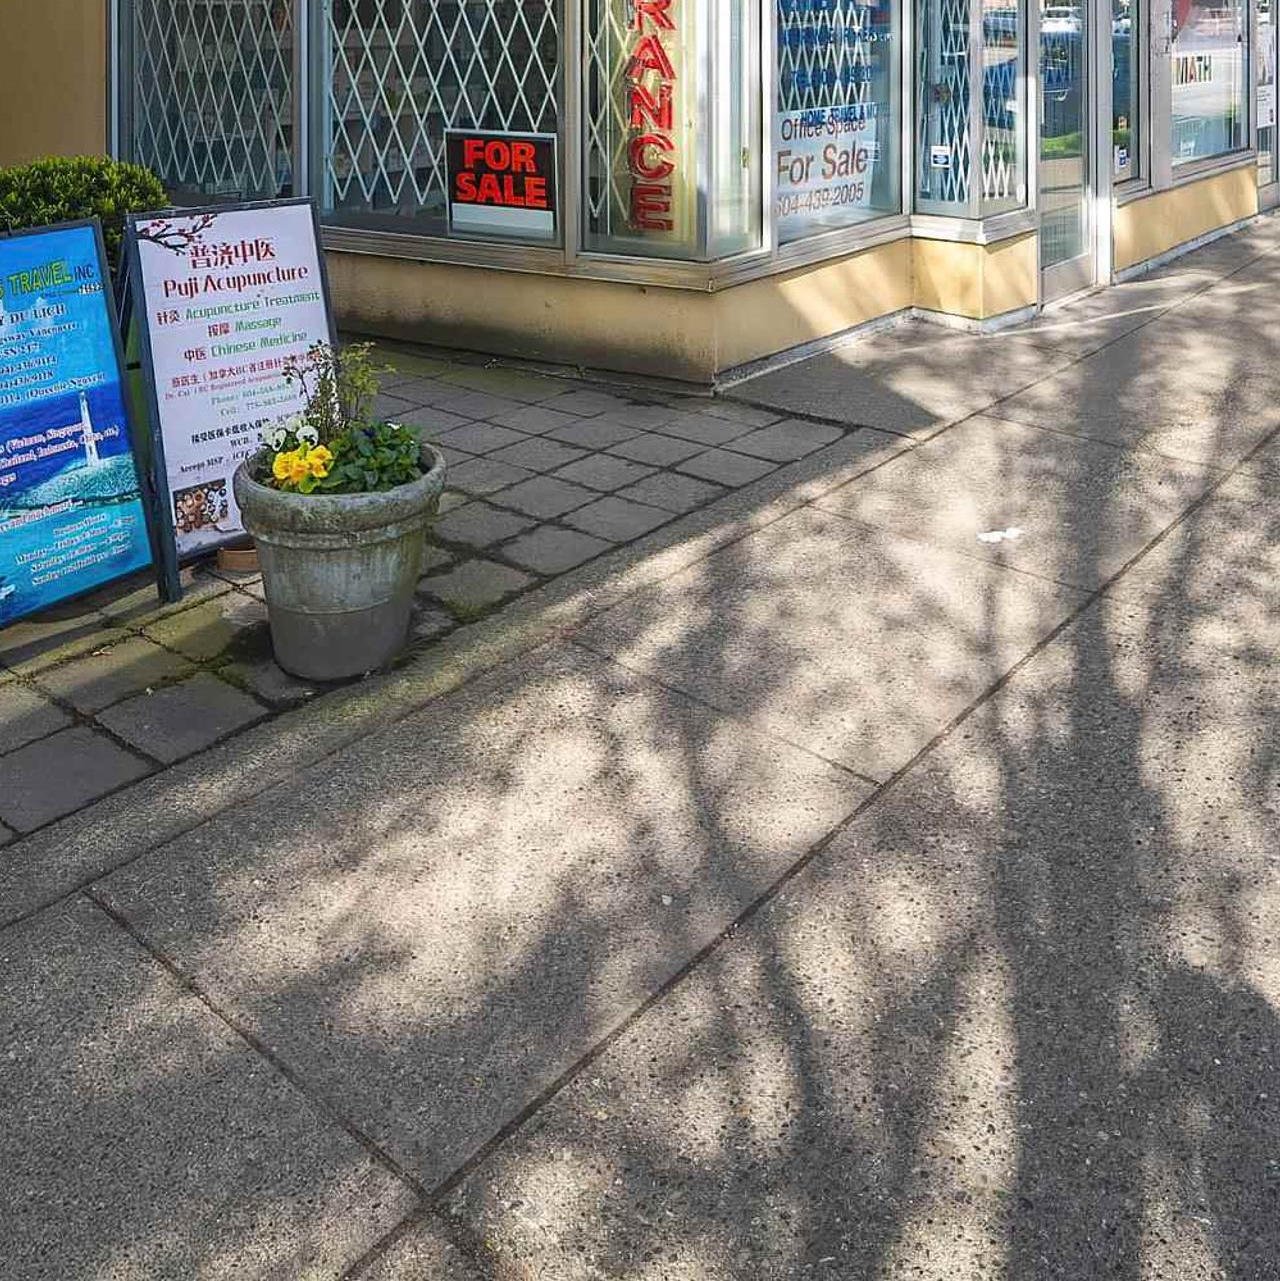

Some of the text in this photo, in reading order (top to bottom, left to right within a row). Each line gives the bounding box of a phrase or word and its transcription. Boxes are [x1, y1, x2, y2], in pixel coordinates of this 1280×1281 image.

[781, 117, 822, 141] Office
[462, 138, 536, 174] FOR
[777, 141, 868, 186] For Sale
[455, 175, 547, 208] SALE
[190, 236, 276, 269] 普济中医
[9, 260, 73, 296] TRAVEL
[74, 264, 95, 282] INC
[163, 266, 308, 299] Puji Acupuncture
[185, 290, 320, 320] Acupuncture Treatment
[235, 317, 282, 333] Massage
[184, 347, 207, 362] 中医
[211, 331, 308, 358] Chinese Medicine
